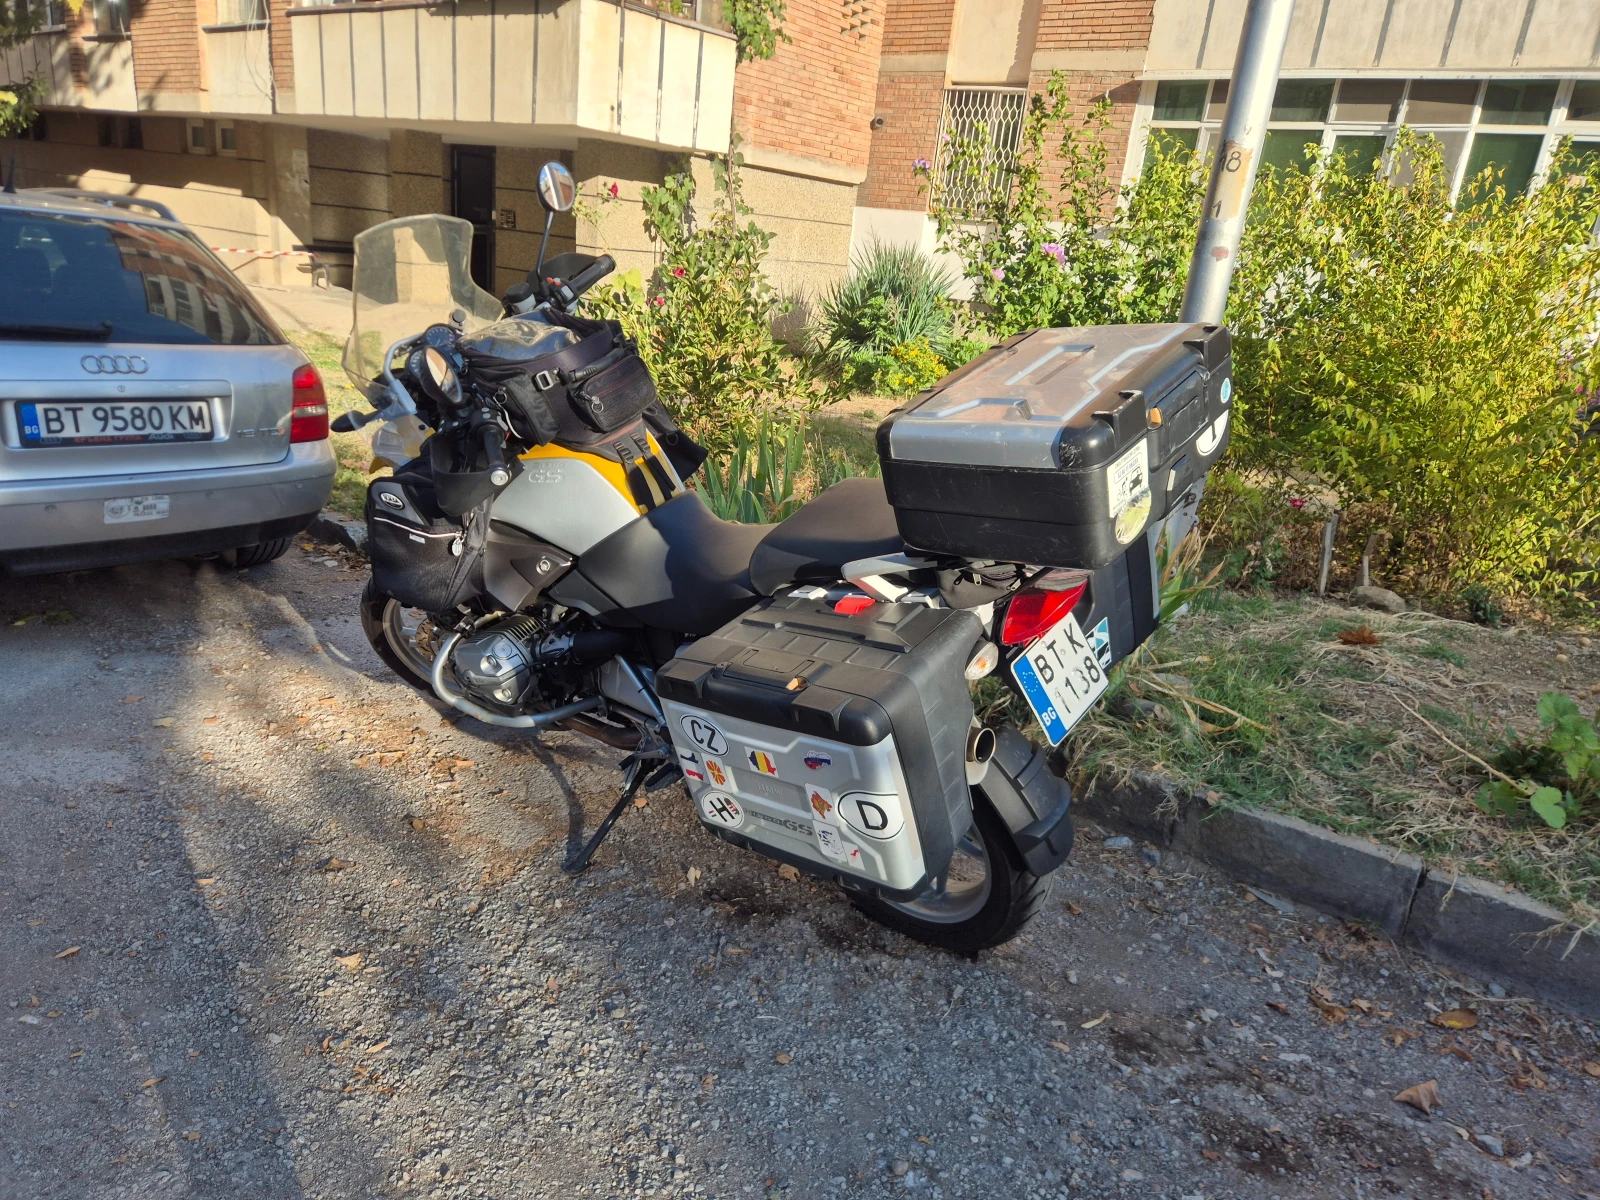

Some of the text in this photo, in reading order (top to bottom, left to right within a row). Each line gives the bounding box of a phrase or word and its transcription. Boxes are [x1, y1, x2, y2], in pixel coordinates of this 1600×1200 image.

[1219, 151, 1242, 172] 18
[24, 425, 39, 434] BG
[43, 405, 206, 434] BT 9580 KM
[528, 469, 566, 483] GS
[1034, 622, 1084, 685] BT K
[1055, 655, 1100, 714] 1138
[1041, 706, 1057, 727] BG
[691, 719, 719, 753] CZ
[709, 797, 735, 822] H
[855, 799, 889, 831] D
